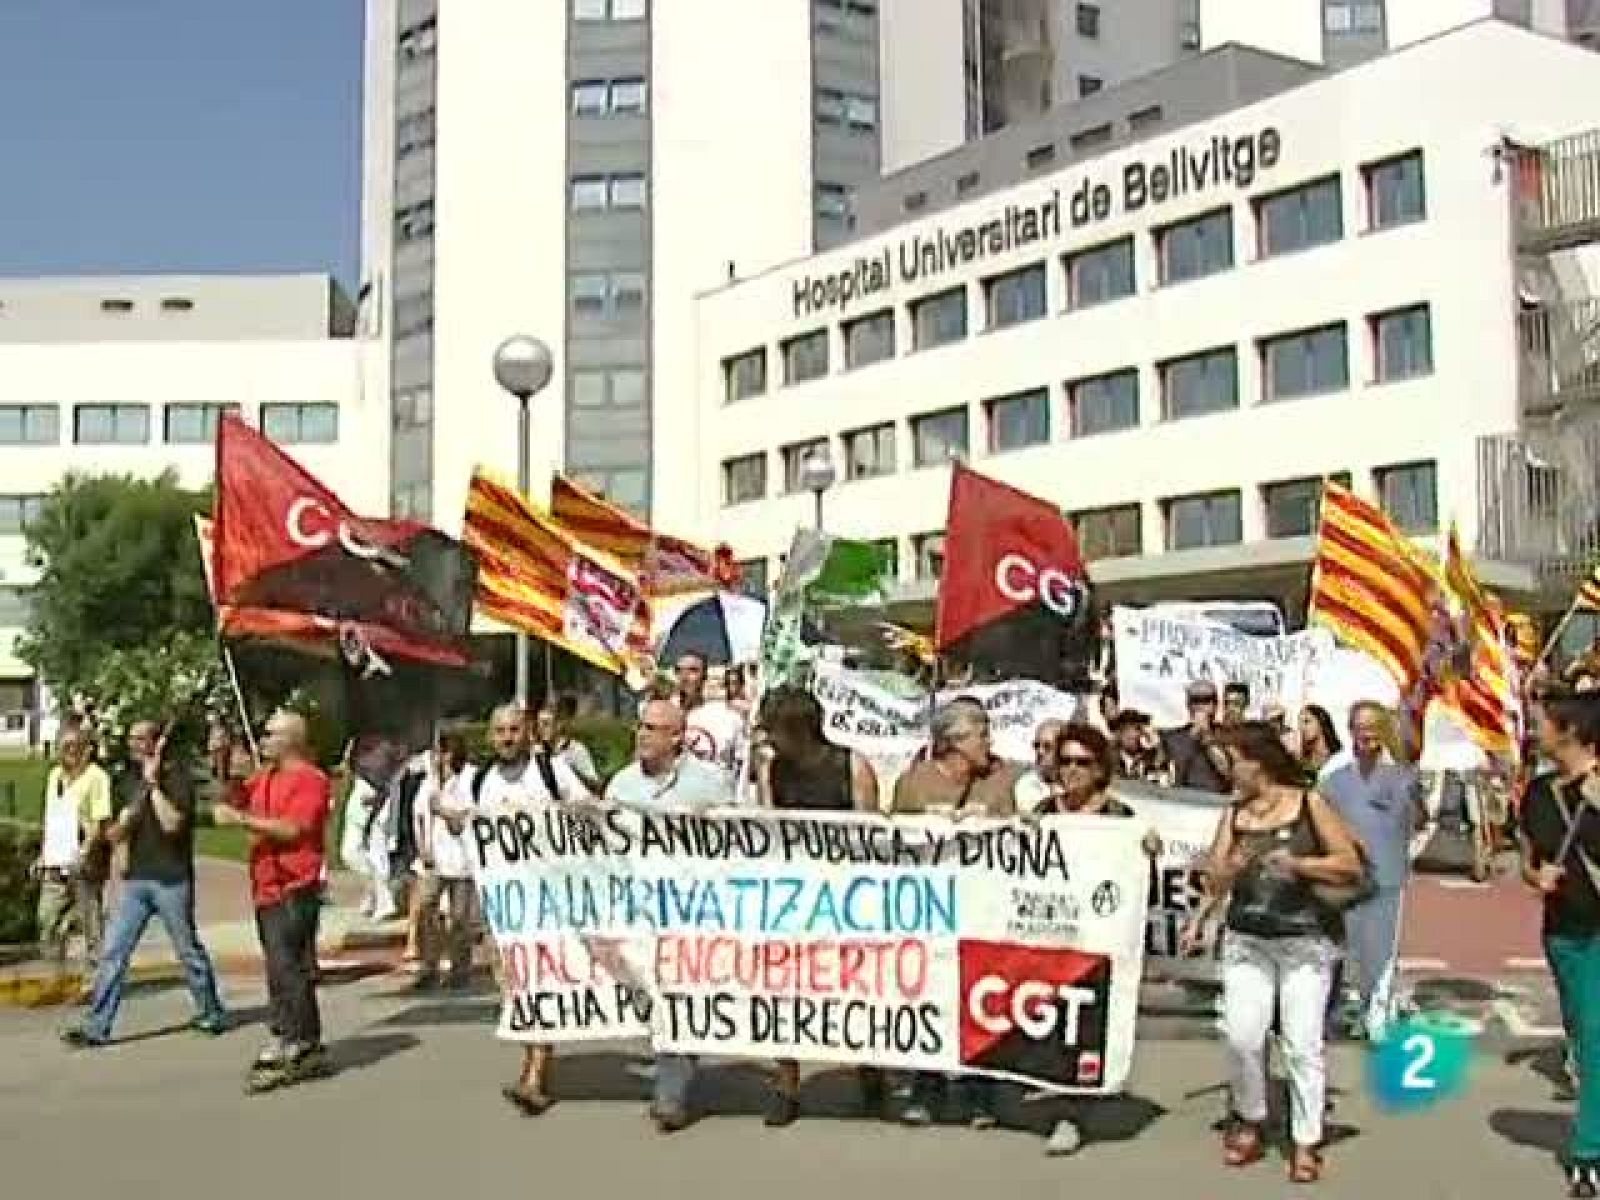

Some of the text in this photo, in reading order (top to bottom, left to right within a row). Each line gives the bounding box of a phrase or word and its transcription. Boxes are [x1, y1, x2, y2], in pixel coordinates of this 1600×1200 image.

[793, 127, 1281, 320] Hospital Universitari de Bellvitge
[473, 811, 540, 866] POR
[780, 819, 919, 866] PUBLICA
[955, 826, 1069, 881] DIGNA
[482, 879, 525, 934] NO
[609, 873, 957, 933] PRIVATIZACION
[654, 935, 928, 998] ENCUBIERTO
[661, 992, 736, 1041] TUS
[751, 996, 943, 1054] DERECHOS
[968, 974, 1097, 1047] CGT
